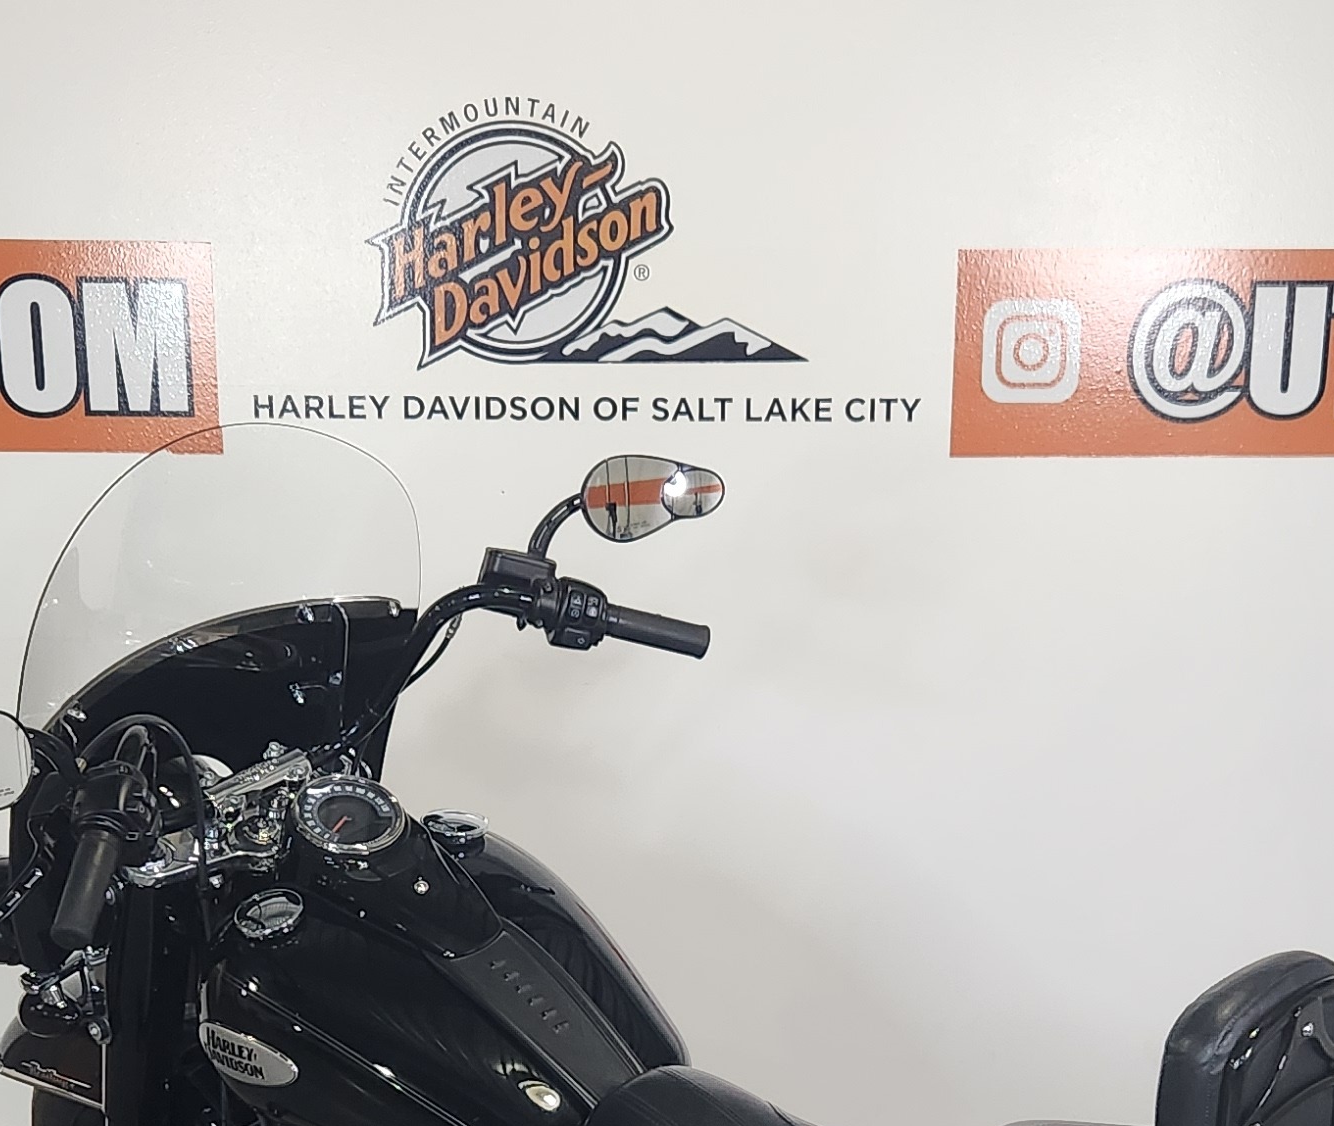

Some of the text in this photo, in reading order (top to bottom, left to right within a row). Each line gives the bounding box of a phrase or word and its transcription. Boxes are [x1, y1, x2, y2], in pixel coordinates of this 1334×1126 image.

[383, 96, 590, 206] INTERMOUNTAIN
[433, 184, 658, 347] Davidson
[251, 394, 922, 422] HARLEY DAVIDSON OF SALT LAKE CITY
